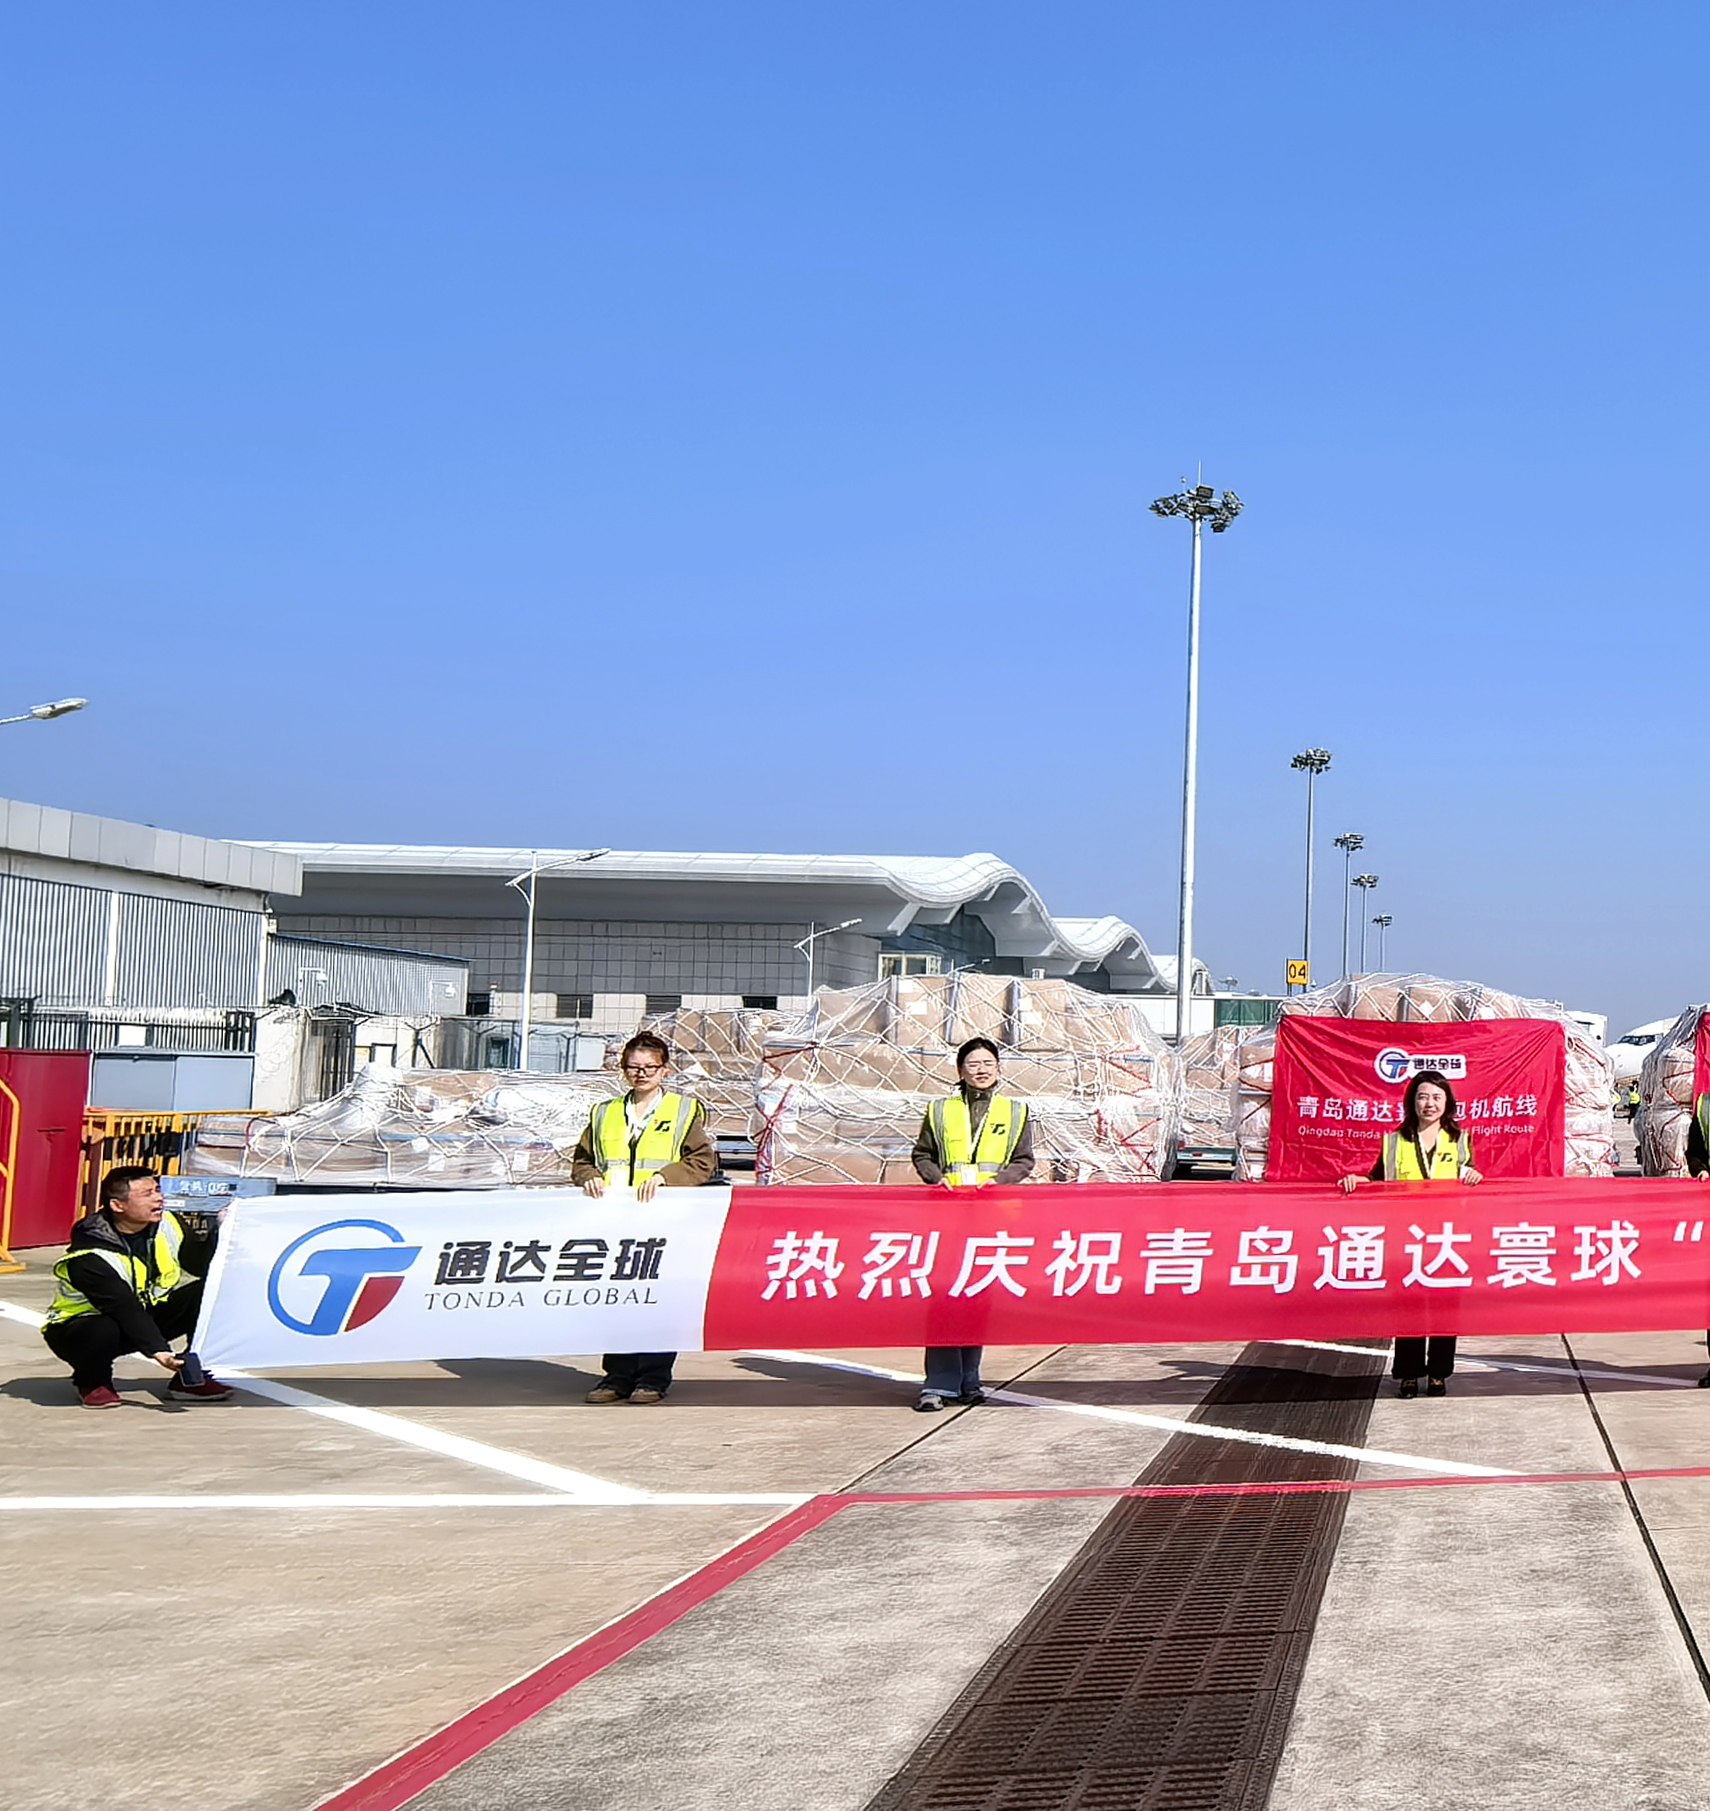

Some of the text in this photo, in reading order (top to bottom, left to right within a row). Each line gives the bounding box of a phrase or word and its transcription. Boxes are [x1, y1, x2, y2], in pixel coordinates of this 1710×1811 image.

[1288, 963, 1306, 979] 04
[433, 1237, 668, 1286] 通达全球
[425, 1286, 659, 1311] TONDA GLOBAL
